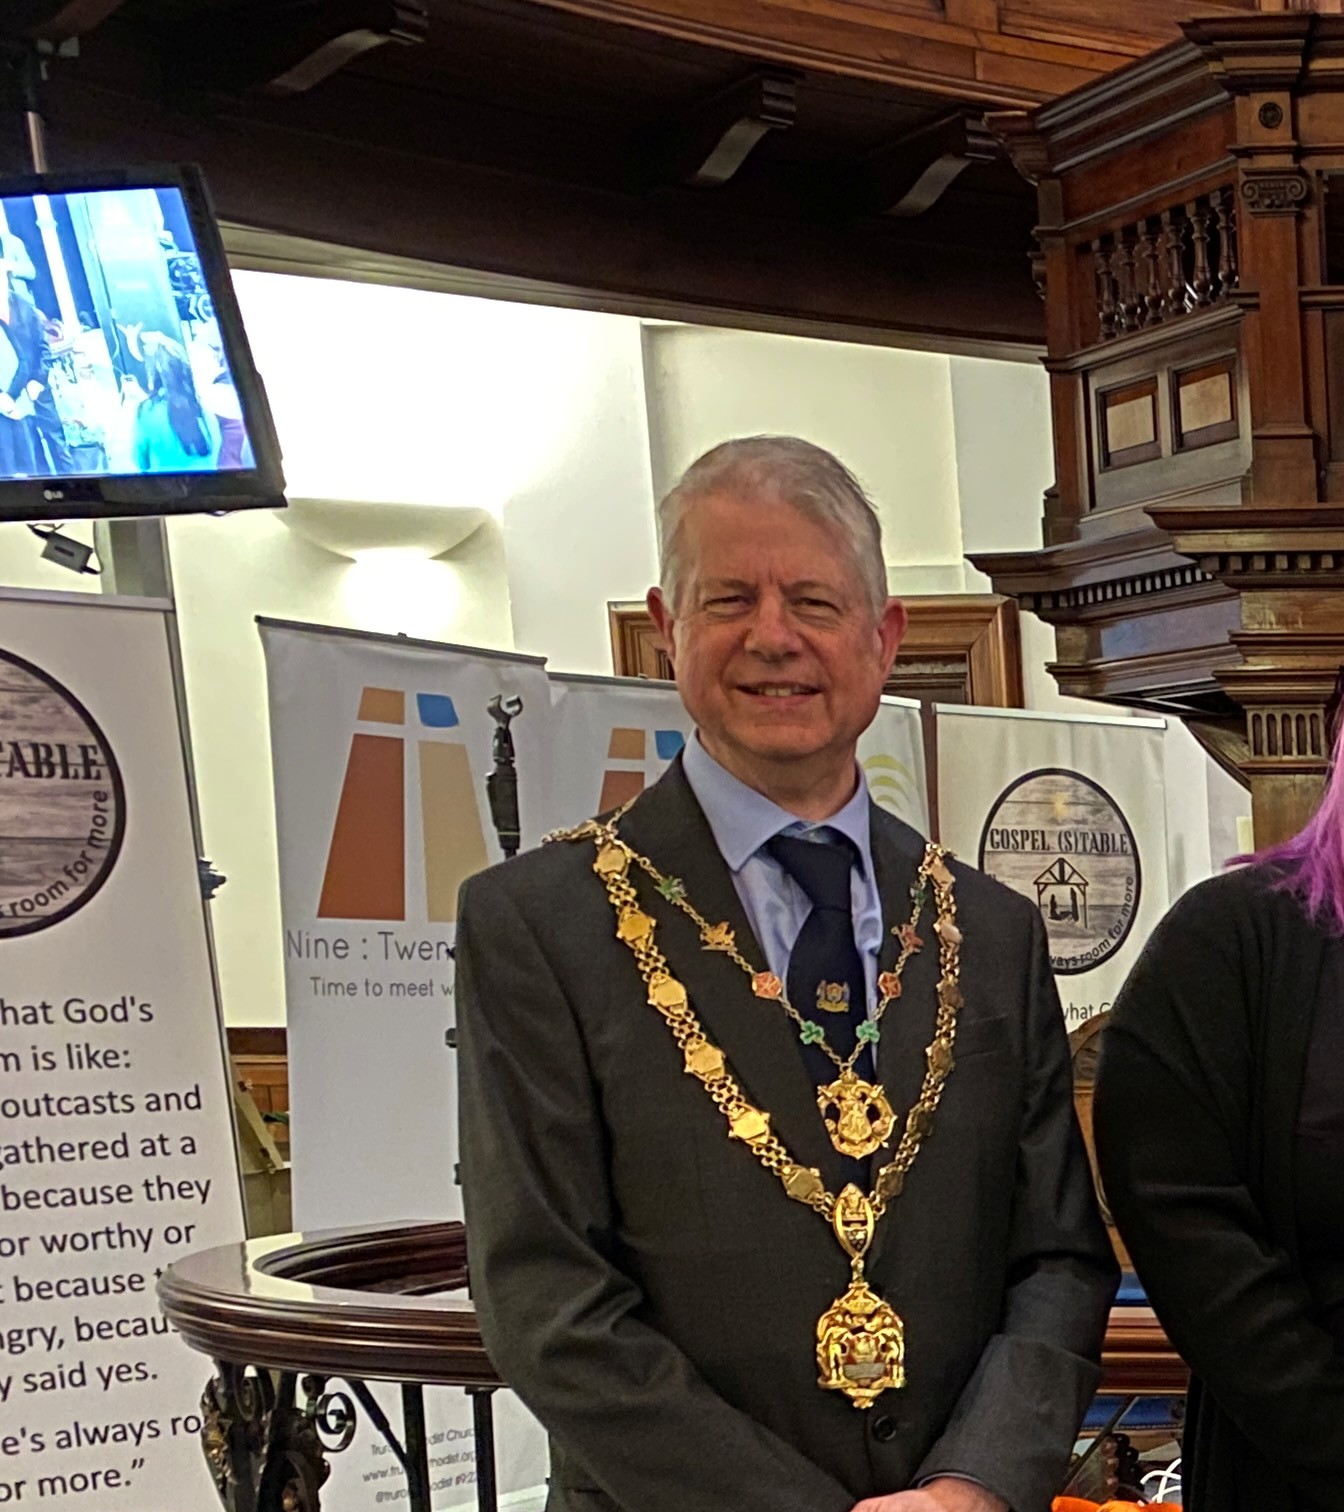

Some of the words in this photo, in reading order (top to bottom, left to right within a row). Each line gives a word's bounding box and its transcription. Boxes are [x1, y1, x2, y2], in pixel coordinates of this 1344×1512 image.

[0, 741, 102, 780] ABLE
[9, 879, 70, 918] room
[63, 850, 95, 882] for
[87, 790, 109, 849] more
[990, 828, 1050, 851] GOSPEL
[1058, 830, 1128, 855] (S)TABLE
[1080, 939, 1111, 963] room
[1108, 919, 1124, 940] for
[1121, 876, 1134, 918] more
[287, 930, 349, 959] Nine
[377, 931, 455, 961] Twen
[310, 977, 358, 997] Time
[365, 979, 383, 997] to
[390, 979, 433, 997] meet
[64, 996, 154, 1024] God's
[31, 1045, 57, 1072] is
[67, 1043, 131, 1070] like:
[1, 1090, 135, 1118] outcasts
[145, 1084, 202, 1112] and
[0, 1132, 129, 1169] athered
[140, 1133, 172, 1157] at
[181, 1135, 196, 1155] a
[2, 1184, 133, 1211] because
[143, 1175, 211, 1204] they
[40, 1222, 153, 1253] worthy
[164, 1224, 196, 1244] or
[13, 1273, 146, 1303] because
[74, 1316, 178, 1342] becau
[24, 1361, 87, 1393] said
[97, 1361, 159, 1391] yes.
[56, 1418, 161, 1450] always
